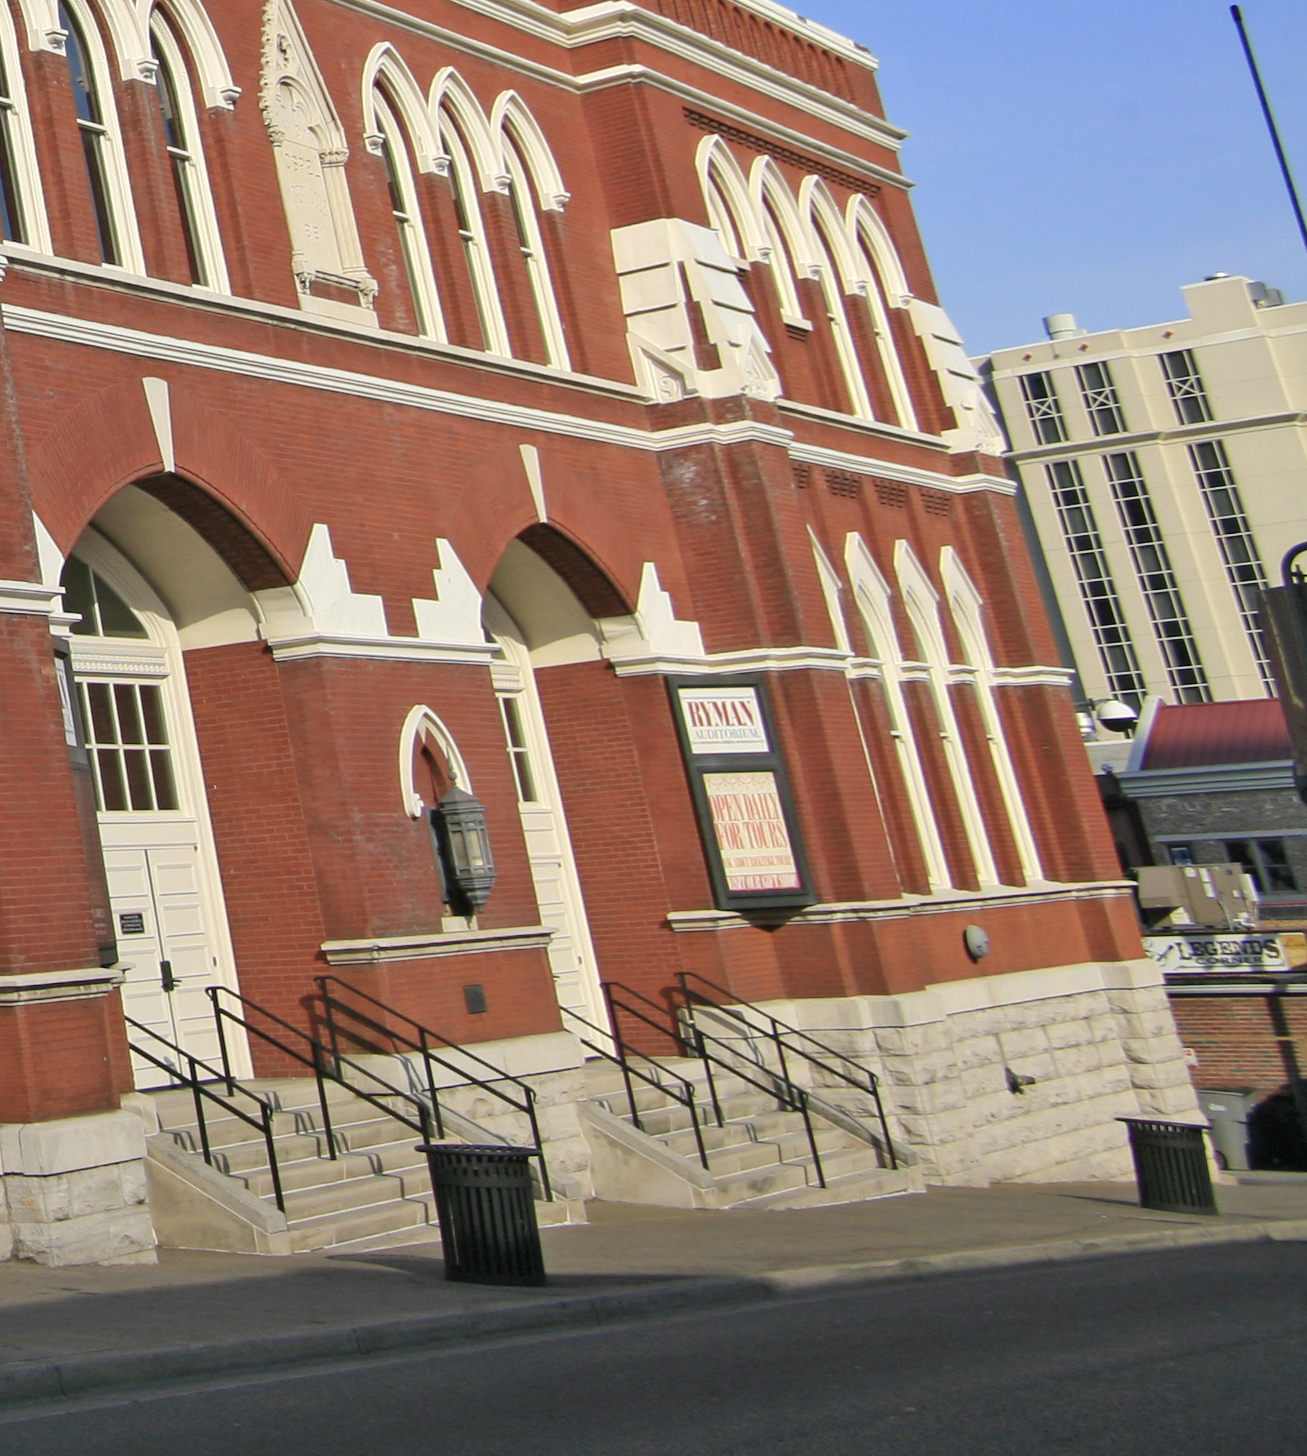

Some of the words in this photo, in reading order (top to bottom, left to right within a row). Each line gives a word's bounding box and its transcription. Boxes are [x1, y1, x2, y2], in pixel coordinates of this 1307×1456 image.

[686, 701, 755, 727] RYMAN
[694, 728, 760, 740] AUDITORIUM
[708, 794, 745, 821] OPEN
[744, 793, 780, 820] DAILY
[714, 822, 744, 850] FOR
[743, 821, 787, 849] TOURS
[1175, 939, 1280, 959] LEGENDS
[1195, 955, 1263, 965] CORNER
